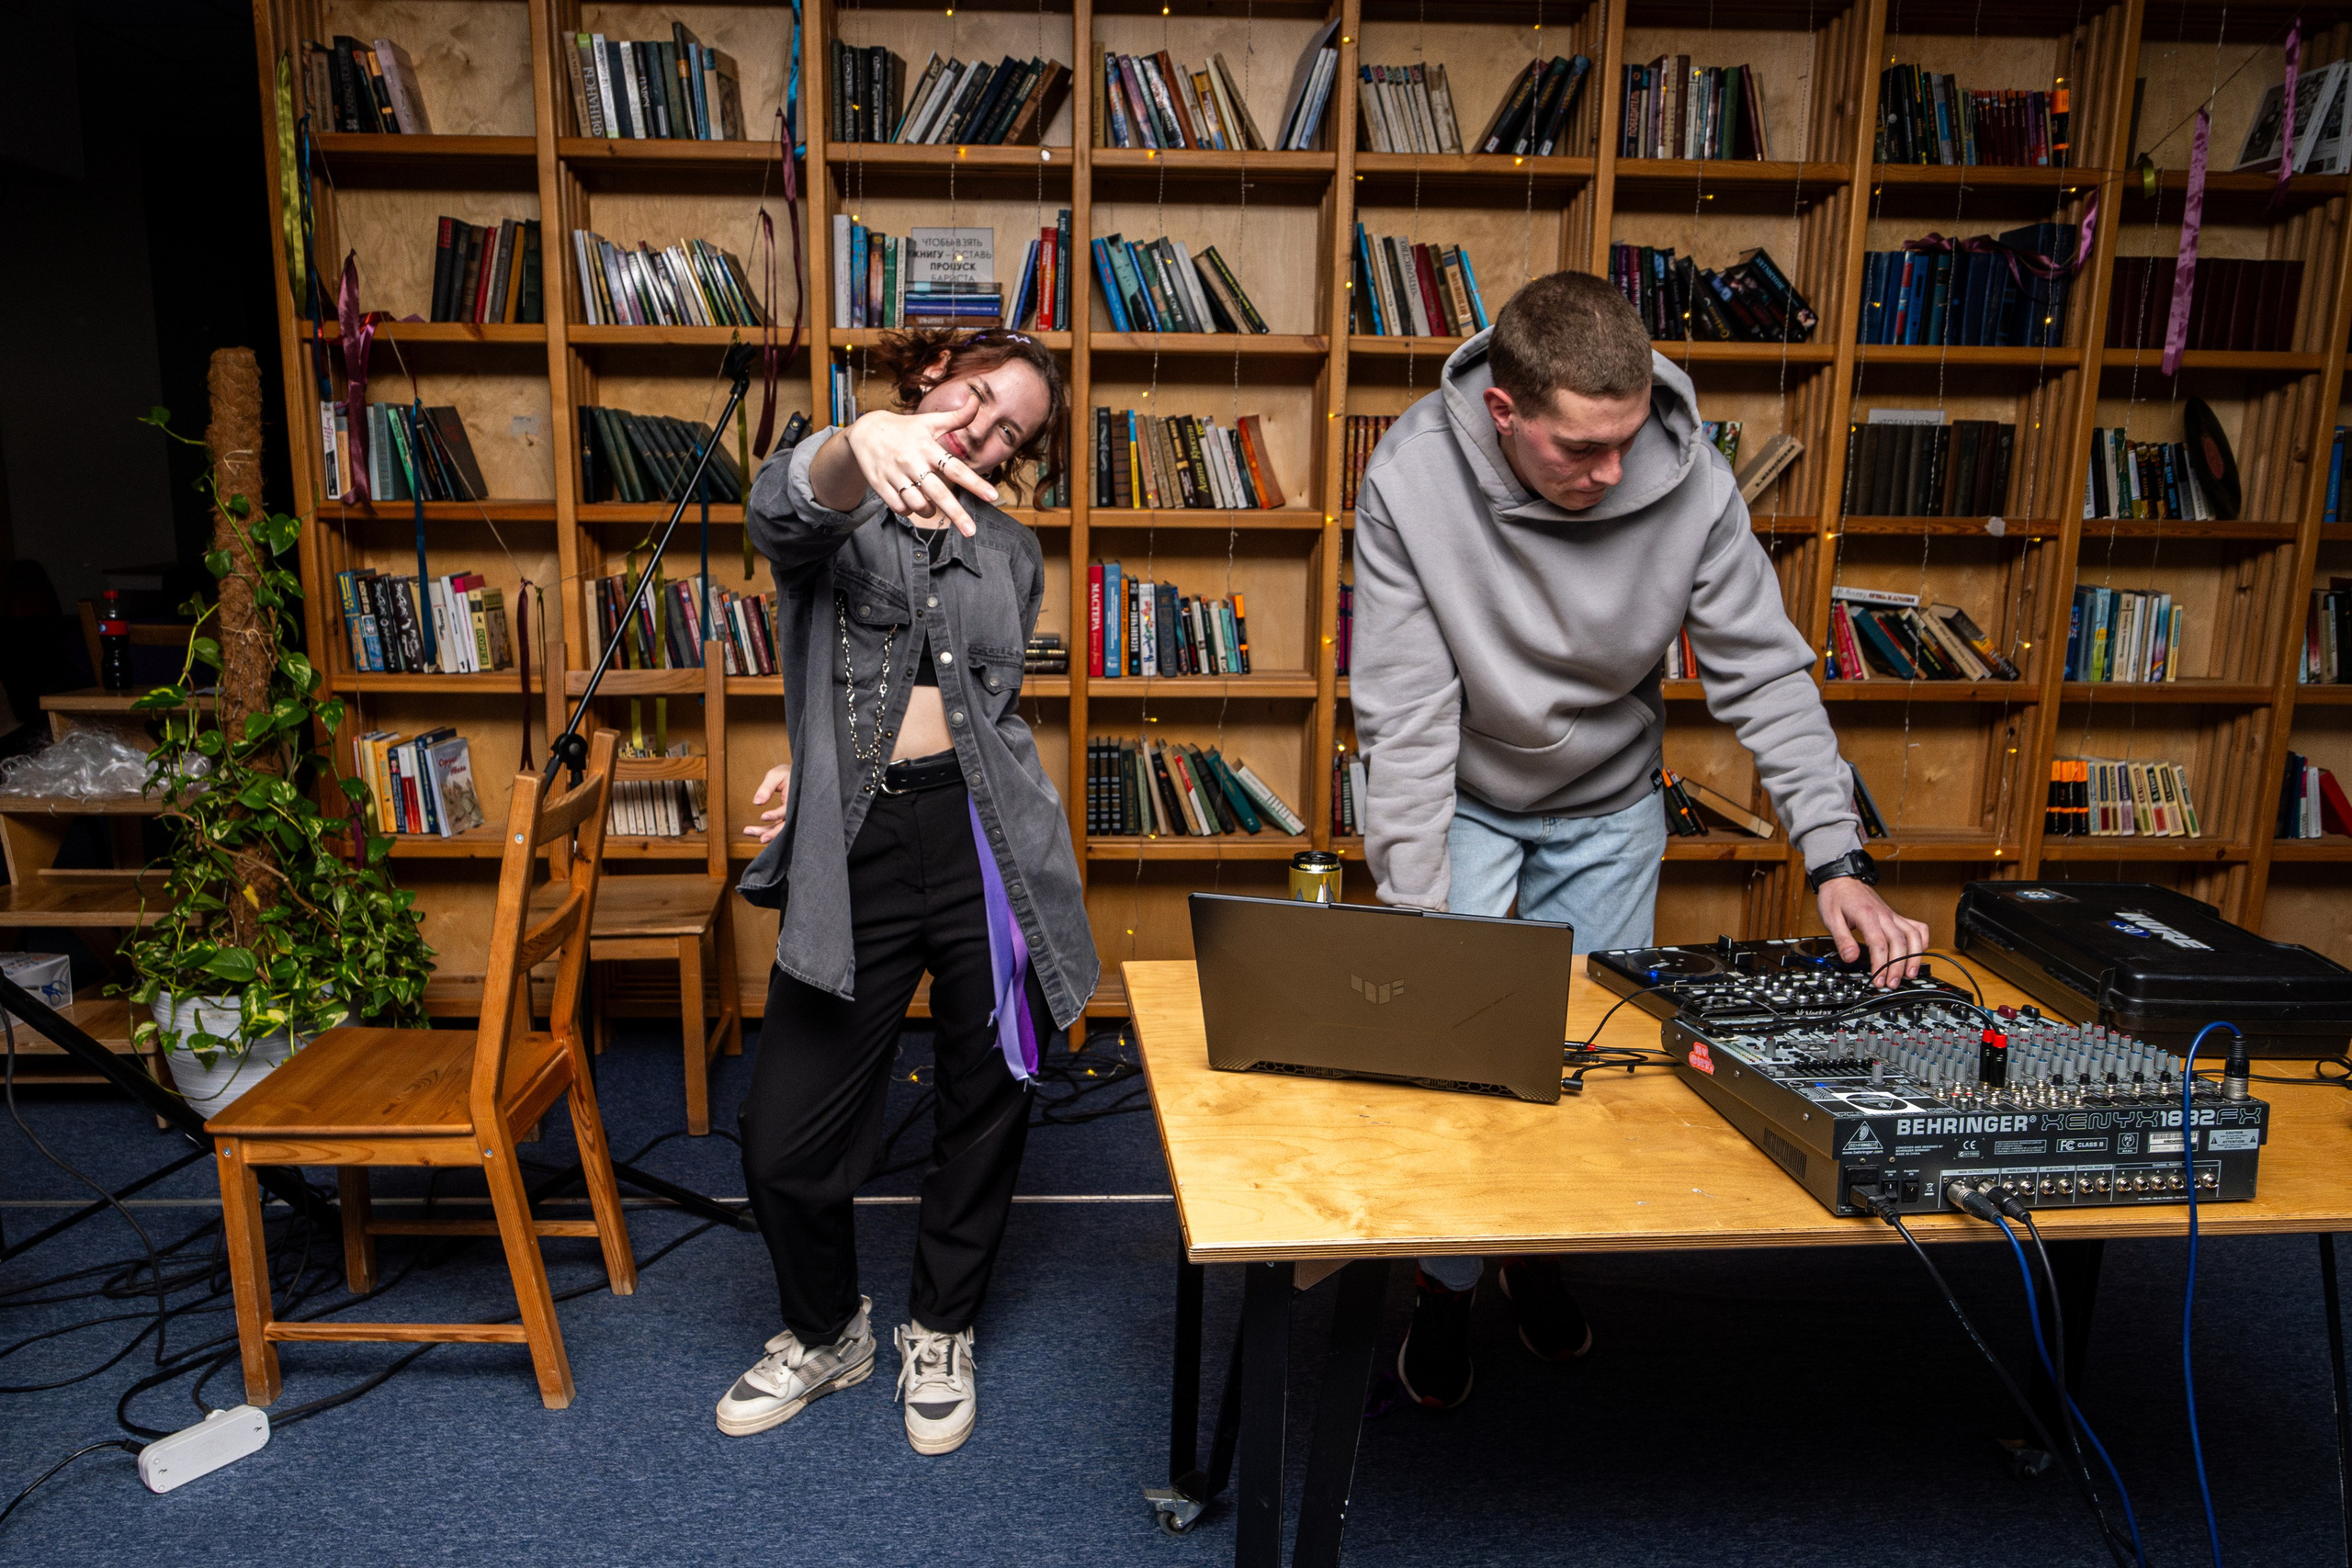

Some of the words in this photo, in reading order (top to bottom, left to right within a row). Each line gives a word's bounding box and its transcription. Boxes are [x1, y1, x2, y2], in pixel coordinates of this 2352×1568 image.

[582, 66, 604, 137] ФИНАНСЫ
[1628, 90, 1641, 137] ПОБЕДИТЕЛЬ
[913, 250, 944, 259] КНИГУ
[922, 238, 953, 246] ЧТОБЫ
[956, 238, 983, 246] ВЗЯТЬ
[931, 262, 977, 271] ПРОПУСК
[1187, 424, 1203, 460] Кристи
[1197, 463, 1209, 494] Агата
[1091, 582, 1100, 631] МАСТЕРА
[476, 629, 489, 665] КОРЕЯ
[2115, 924, 2144, 934] 30
[1896, 1115, 2029, 1135] BEHRINGER
